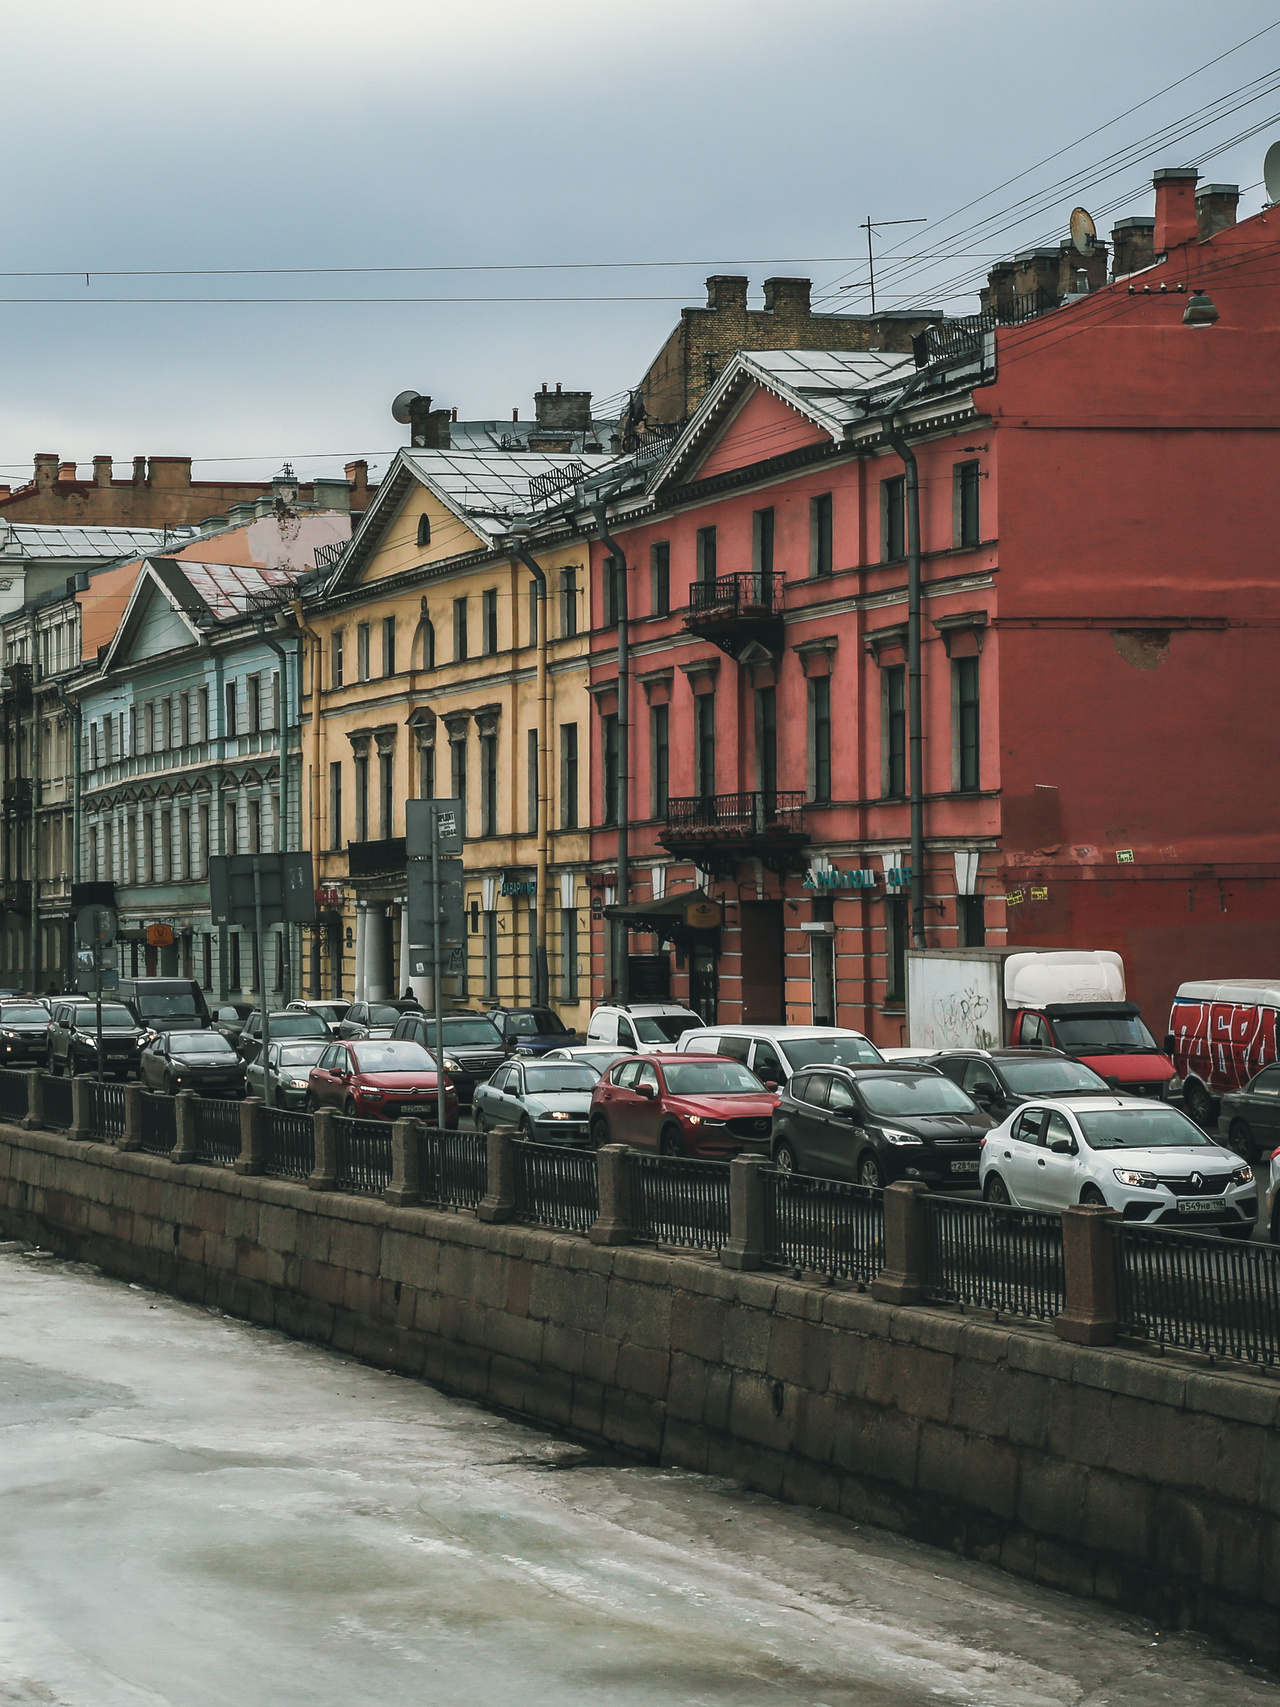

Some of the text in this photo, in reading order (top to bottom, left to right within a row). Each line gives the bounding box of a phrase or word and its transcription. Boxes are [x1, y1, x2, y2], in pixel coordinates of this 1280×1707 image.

[817, 870, 838, 889] PHO
[887, 867, 912, 887] CAFE
[1180, 1201, 1210, 1211] В549НВ
